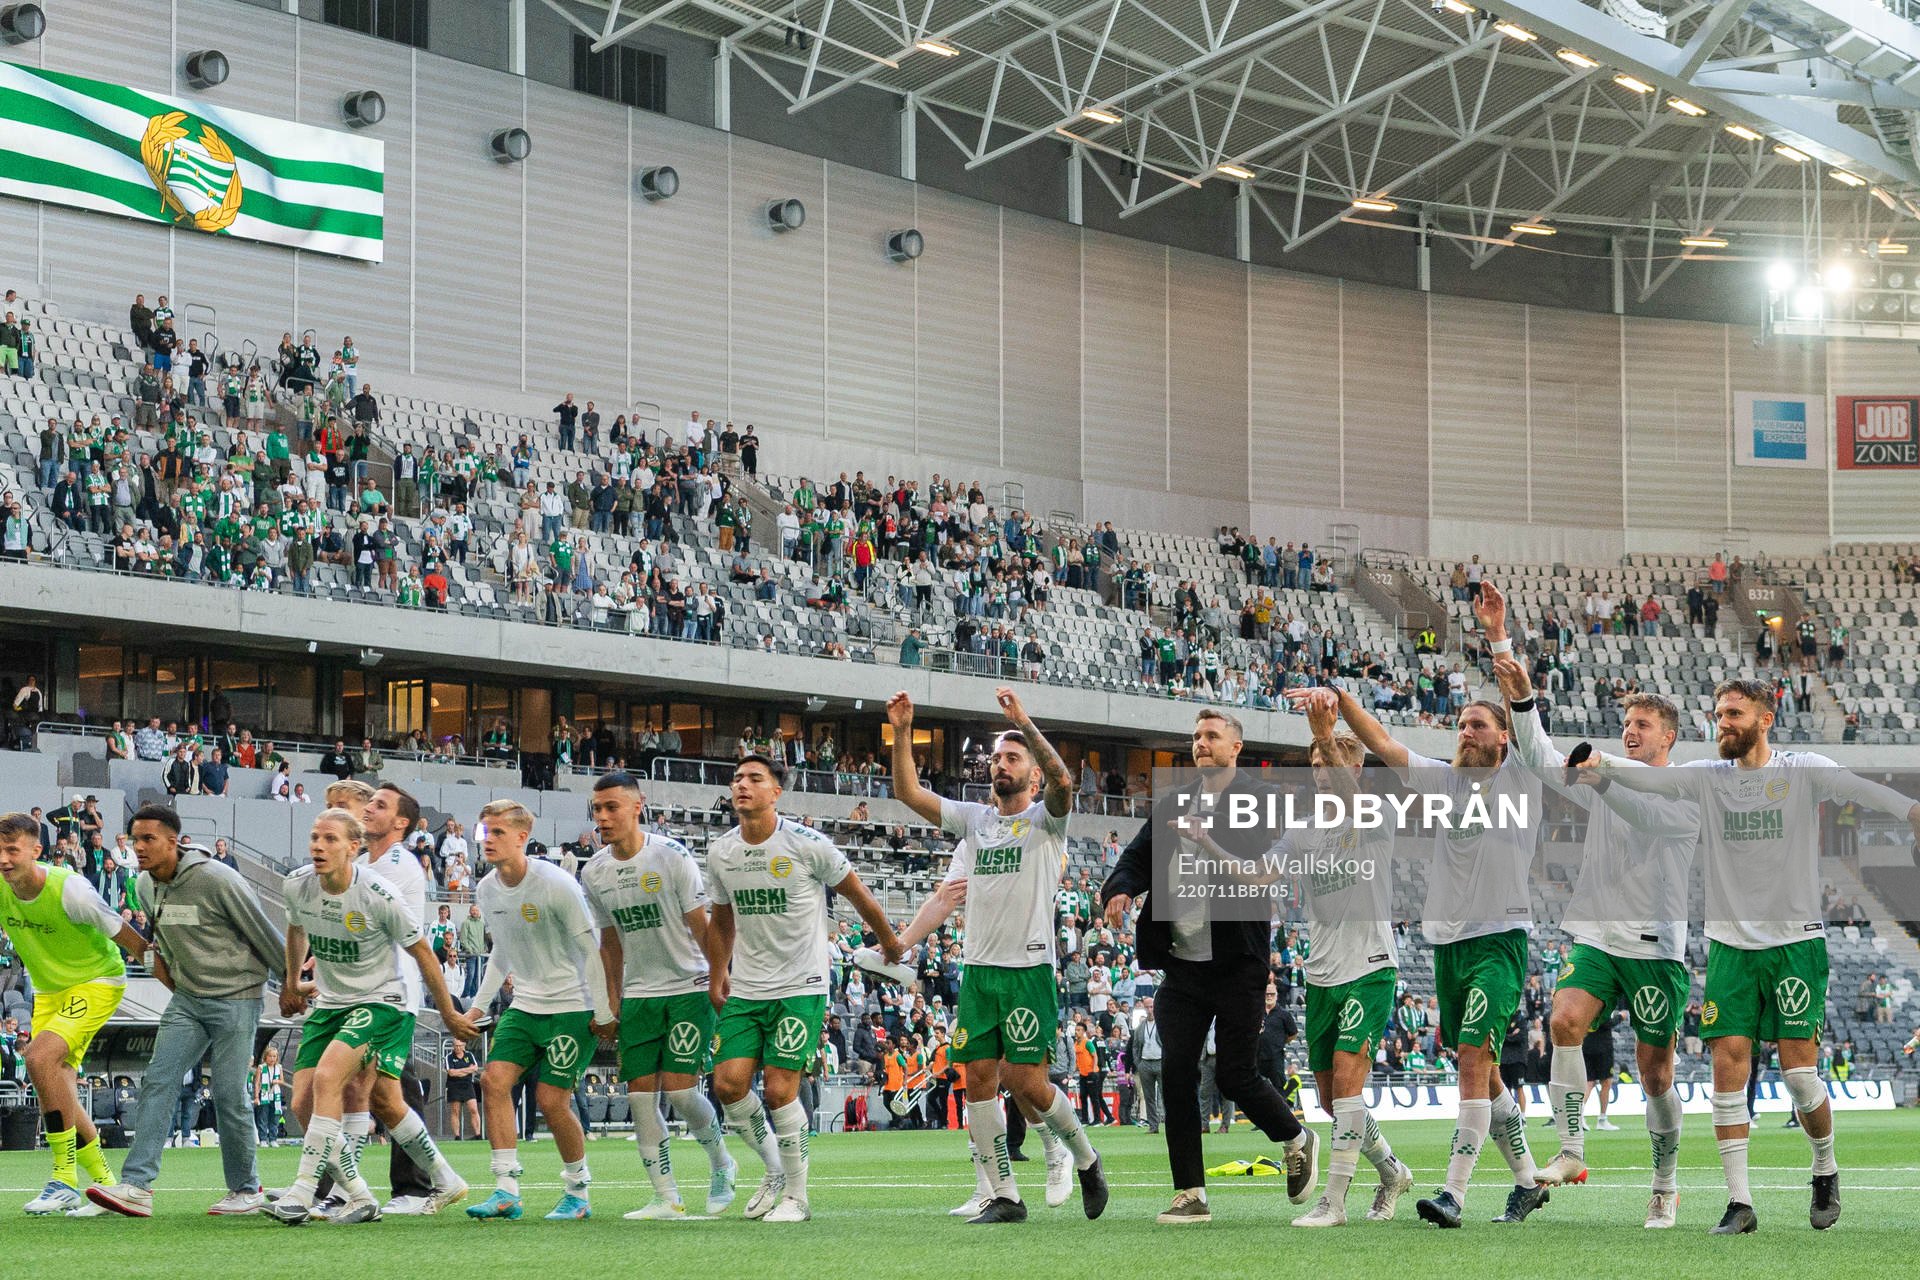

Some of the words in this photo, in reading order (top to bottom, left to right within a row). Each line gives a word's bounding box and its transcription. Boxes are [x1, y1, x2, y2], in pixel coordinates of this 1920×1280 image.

[1754, 420, 1804, 432] AMERICAN
[1858, 405, 1908, 439] JOB
[1764, 432, 1807, 443] EXPRESS
[1855, 444, 1918, 463] ZONE
[1748, 588, 1775, 601] B321
[1724, 808, 1783, 831] HUSKI
[1723, 829, 1784, 841] CHOCOLATE
[975, 846, 1022, 866] HUSKI
[973, 864, 1021, 875] CHOCOLATE
[733, 887, 787, 906] HUSKI
[737, 904, 788, 915] CHOCOLATE
[308, 933, 360, 956] HUSKI
[1565, 1091, 1585, 1137] Clinton.
[659, 1136, 671, 1176] Clinto
[993, 1133, 1011, 1182] Clinton.
